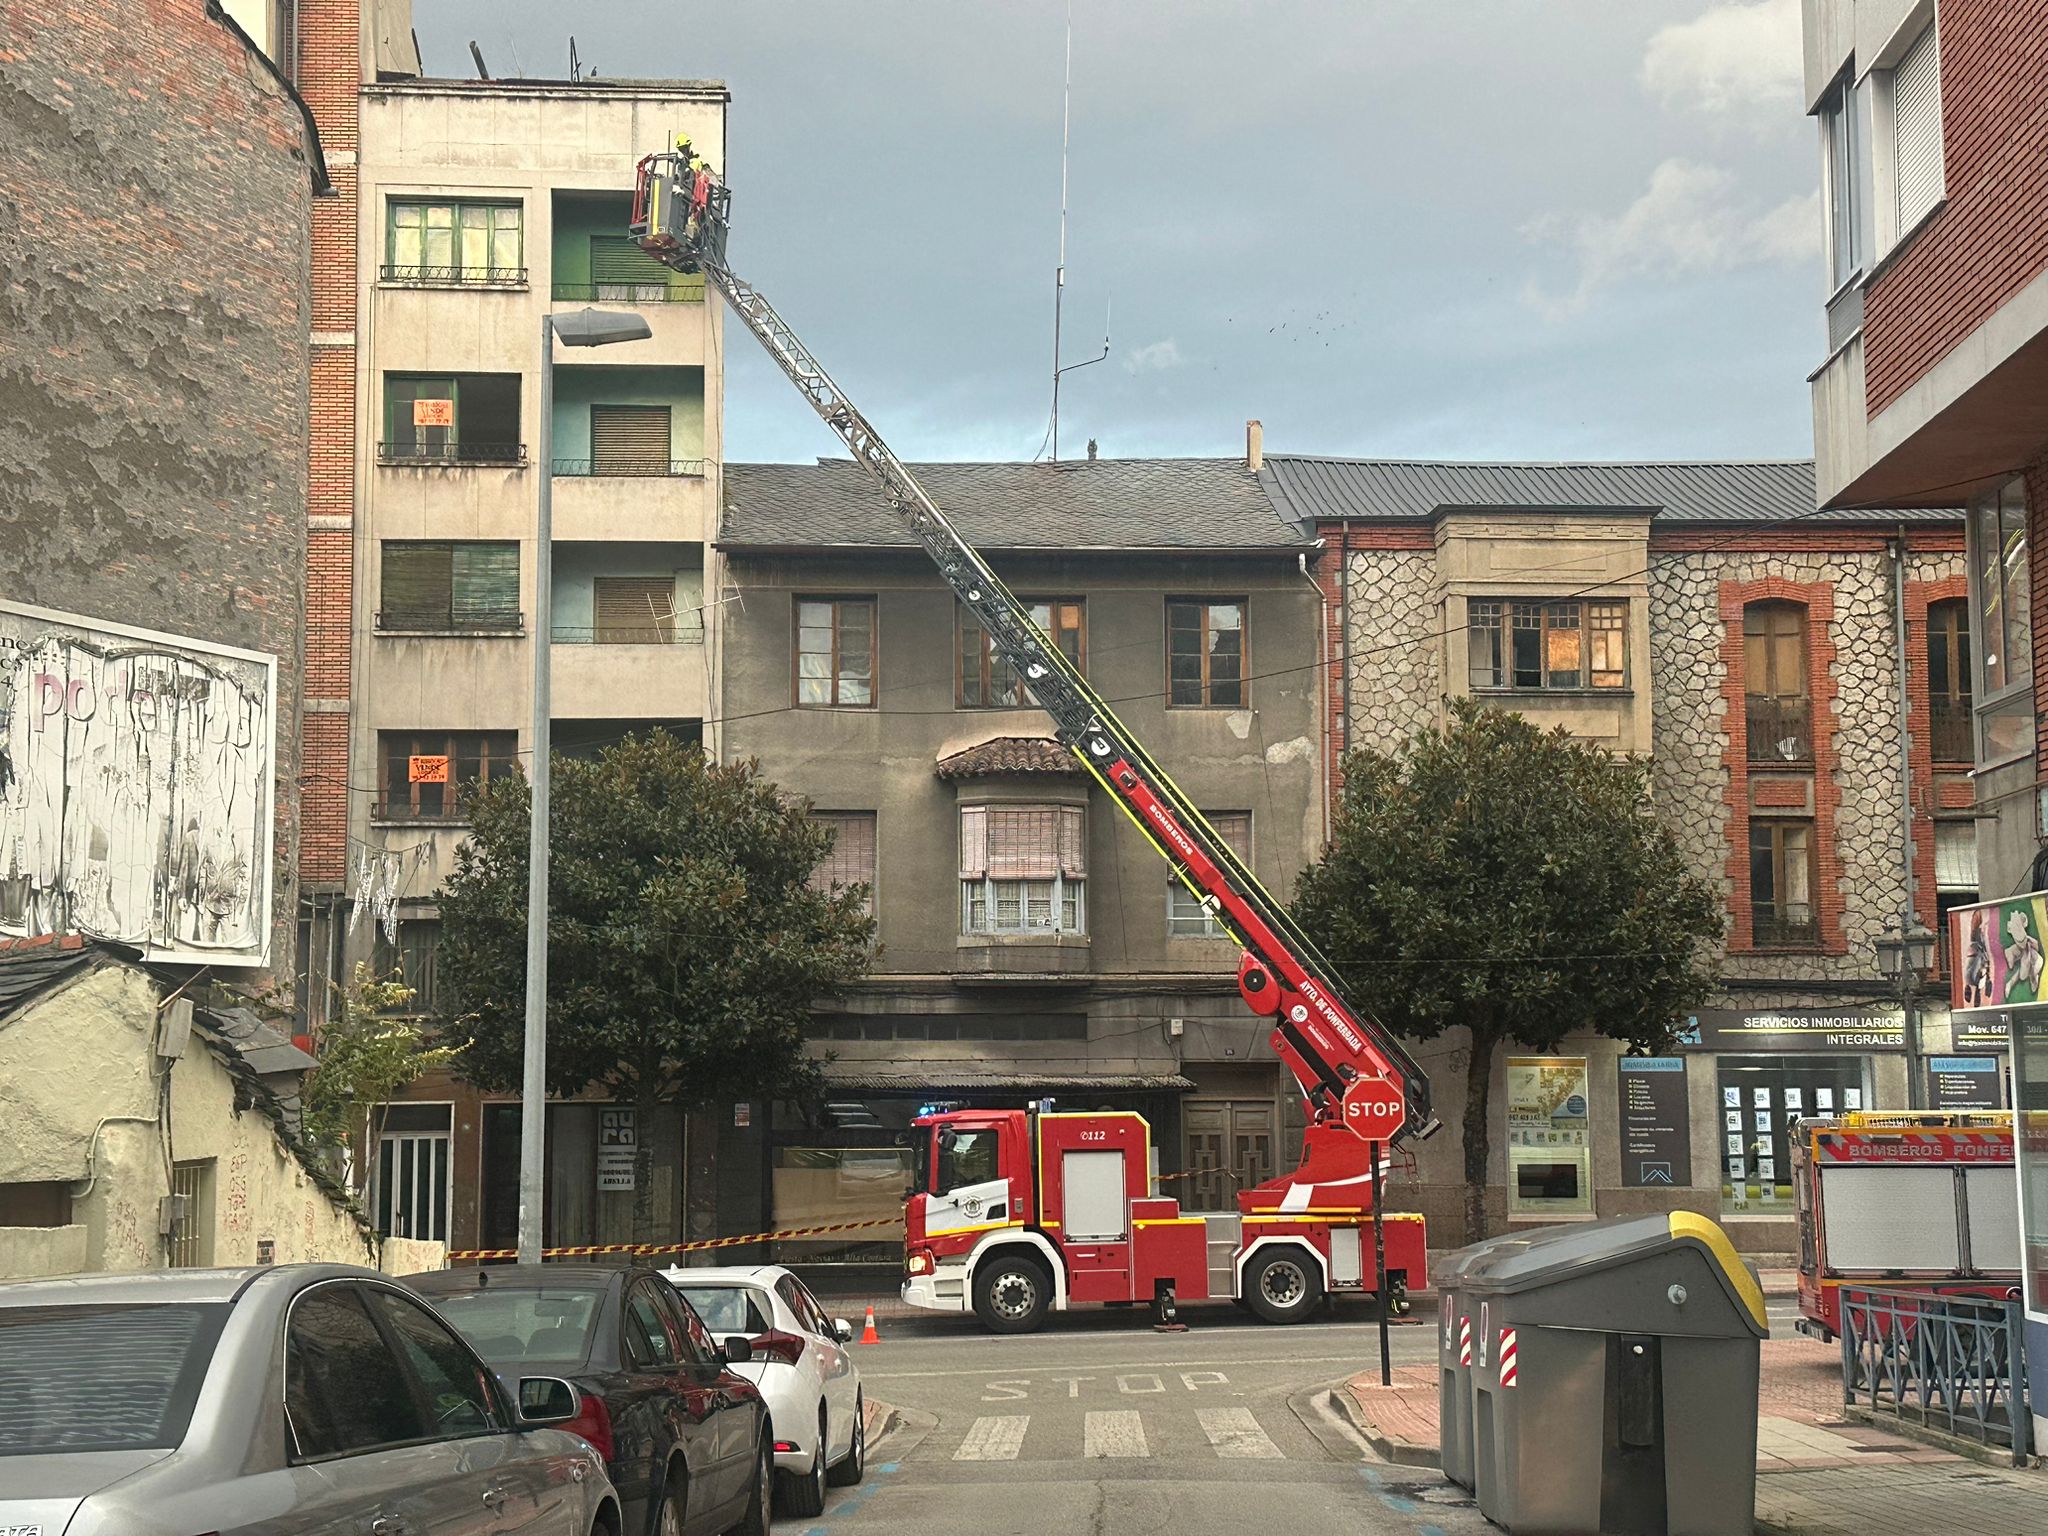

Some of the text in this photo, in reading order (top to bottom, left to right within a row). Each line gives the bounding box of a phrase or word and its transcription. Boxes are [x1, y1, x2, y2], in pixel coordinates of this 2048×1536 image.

[1149, 804, 1194, 855] BOMBEROS
[1299, 980, 1317, 1002] AYTO.
[1315, 997, 1328, 1012] DE
[1323, 1007, 1363, 1052] PONFERRADA
[1743, 1017, 1904, 1029] SERVICIOS INMOBILIARIOS
[1967, 1024, 1990, 1034] Mov.
[1826, 1034, 1904, 1045] INTEGRALES
[1348, 1102, 1401, 1117] STOP
[1088, 1131, 1106, 1141] 112
[1848, 1145, 1943, 1157] BOMBEROS
[980, 1371, 1231, 1402] STOP
